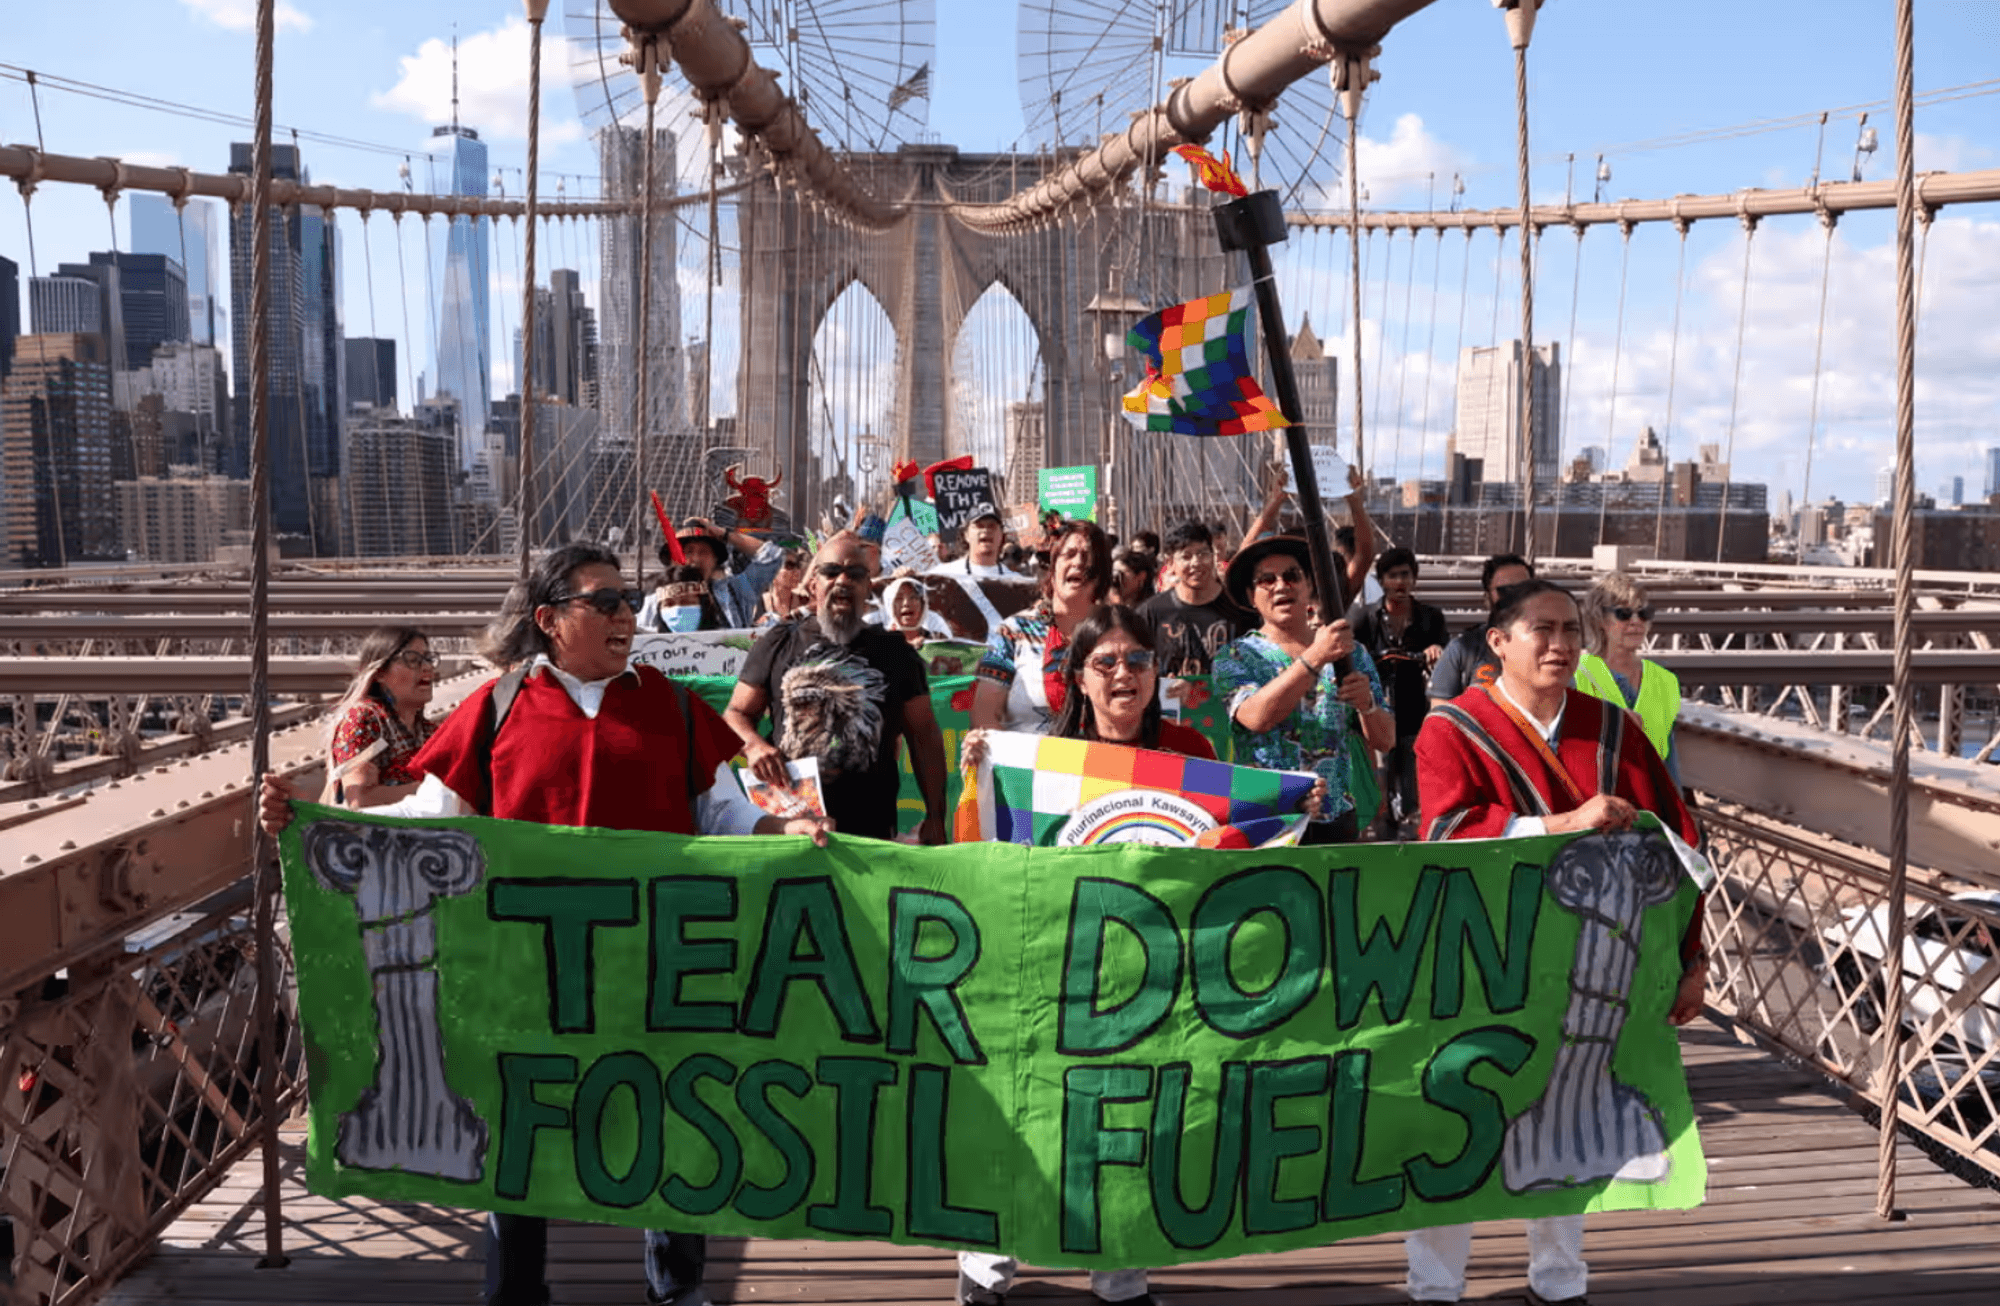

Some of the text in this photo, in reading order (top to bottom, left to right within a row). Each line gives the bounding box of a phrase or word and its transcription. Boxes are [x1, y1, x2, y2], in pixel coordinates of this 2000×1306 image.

[934, 474, 988, 494] REMOVE
[633, 646, 708, 664] GET OUT OF
[1066, 796, 1144, 843] Plurinacional
[488, 863, 1544, 1065] TEAR DOWN
[496, 1024, 1538, 1254] FOSSIL FUELS
